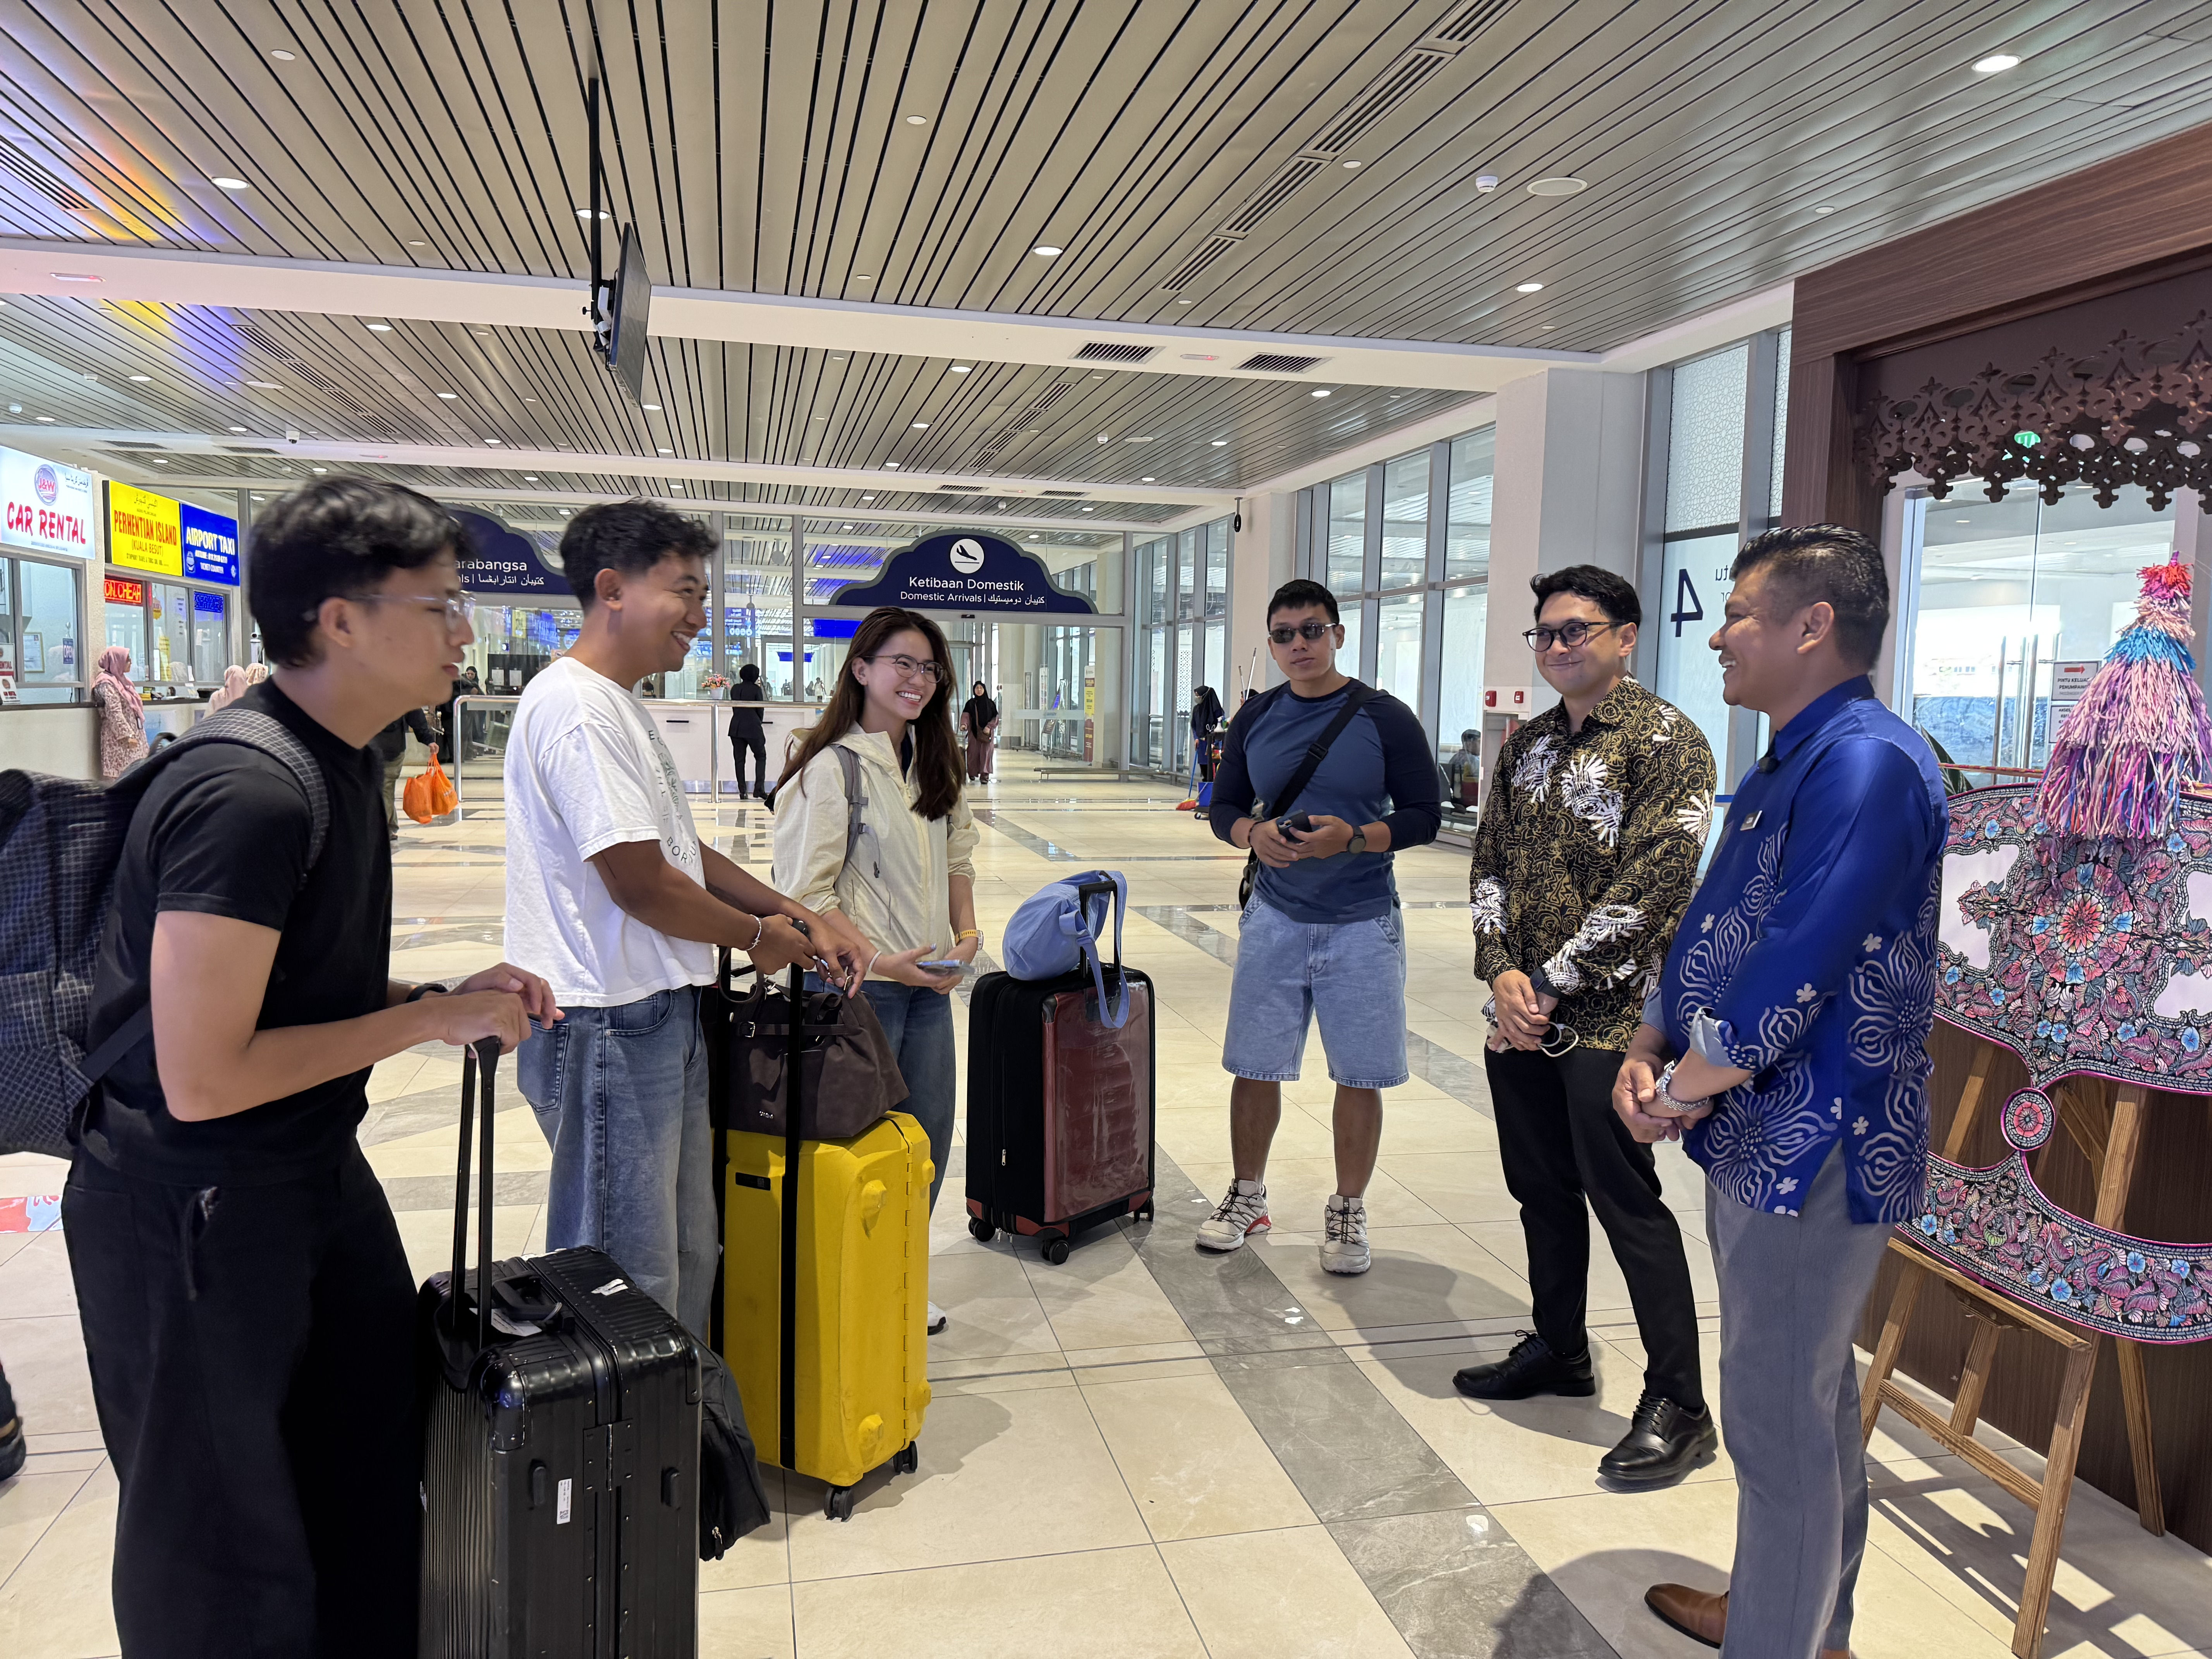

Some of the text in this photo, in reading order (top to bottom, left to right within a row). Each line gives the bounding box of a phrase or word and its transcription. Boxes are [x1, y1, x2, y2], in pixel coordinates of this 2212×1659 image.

[7, 501, 86, 544] CAR RENTAL
[114, 510, 177, 546] PERHENTIAN ISLAND
[132, 539, 163, 557] (KUALA BESUT)
[186, 526, 235, 555] AIRPORT TAXI
[455, 558, 527, 572] arabangsa
[909, 577, 1024, 591] Ketibaan Domestik
[900, 591, 982, 602] Domestic Arrivals
